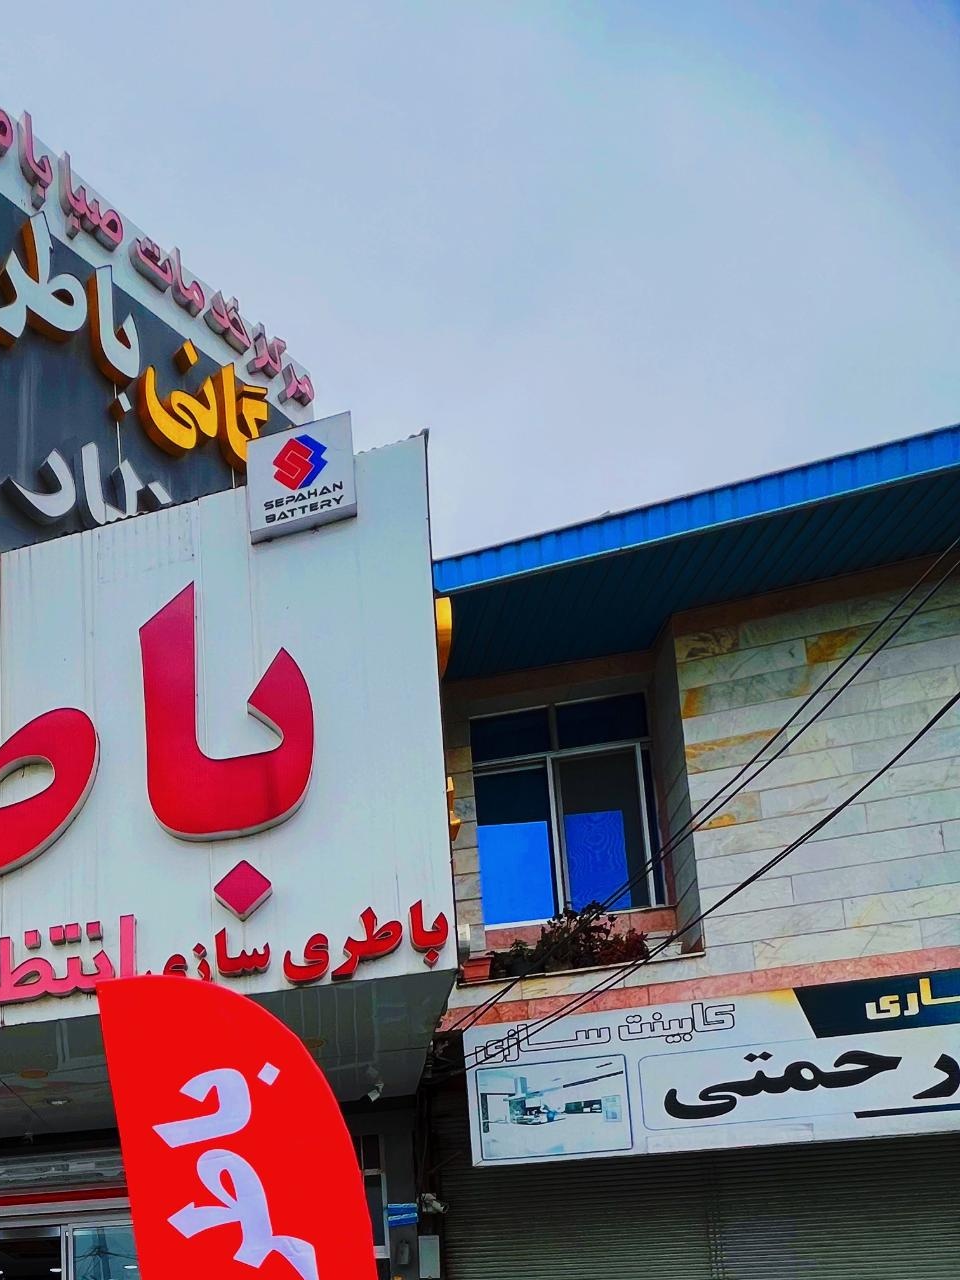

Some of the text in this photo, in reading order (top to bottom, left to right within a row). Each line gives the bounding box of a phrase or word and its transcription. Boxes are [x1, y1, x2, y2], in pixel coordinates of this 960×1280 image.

[58, 150, 124, 252] صبا
[128, 236, 251, 355] خدمات
[263, 480, 343, 511] SEPAHAN
[265, 494, 344, 524] BATTERY
[283, 899, 449, 985] باطری
[865, 977, 960, 1020] اری
[475, 1003, 735, 1064] کابینت سازی
